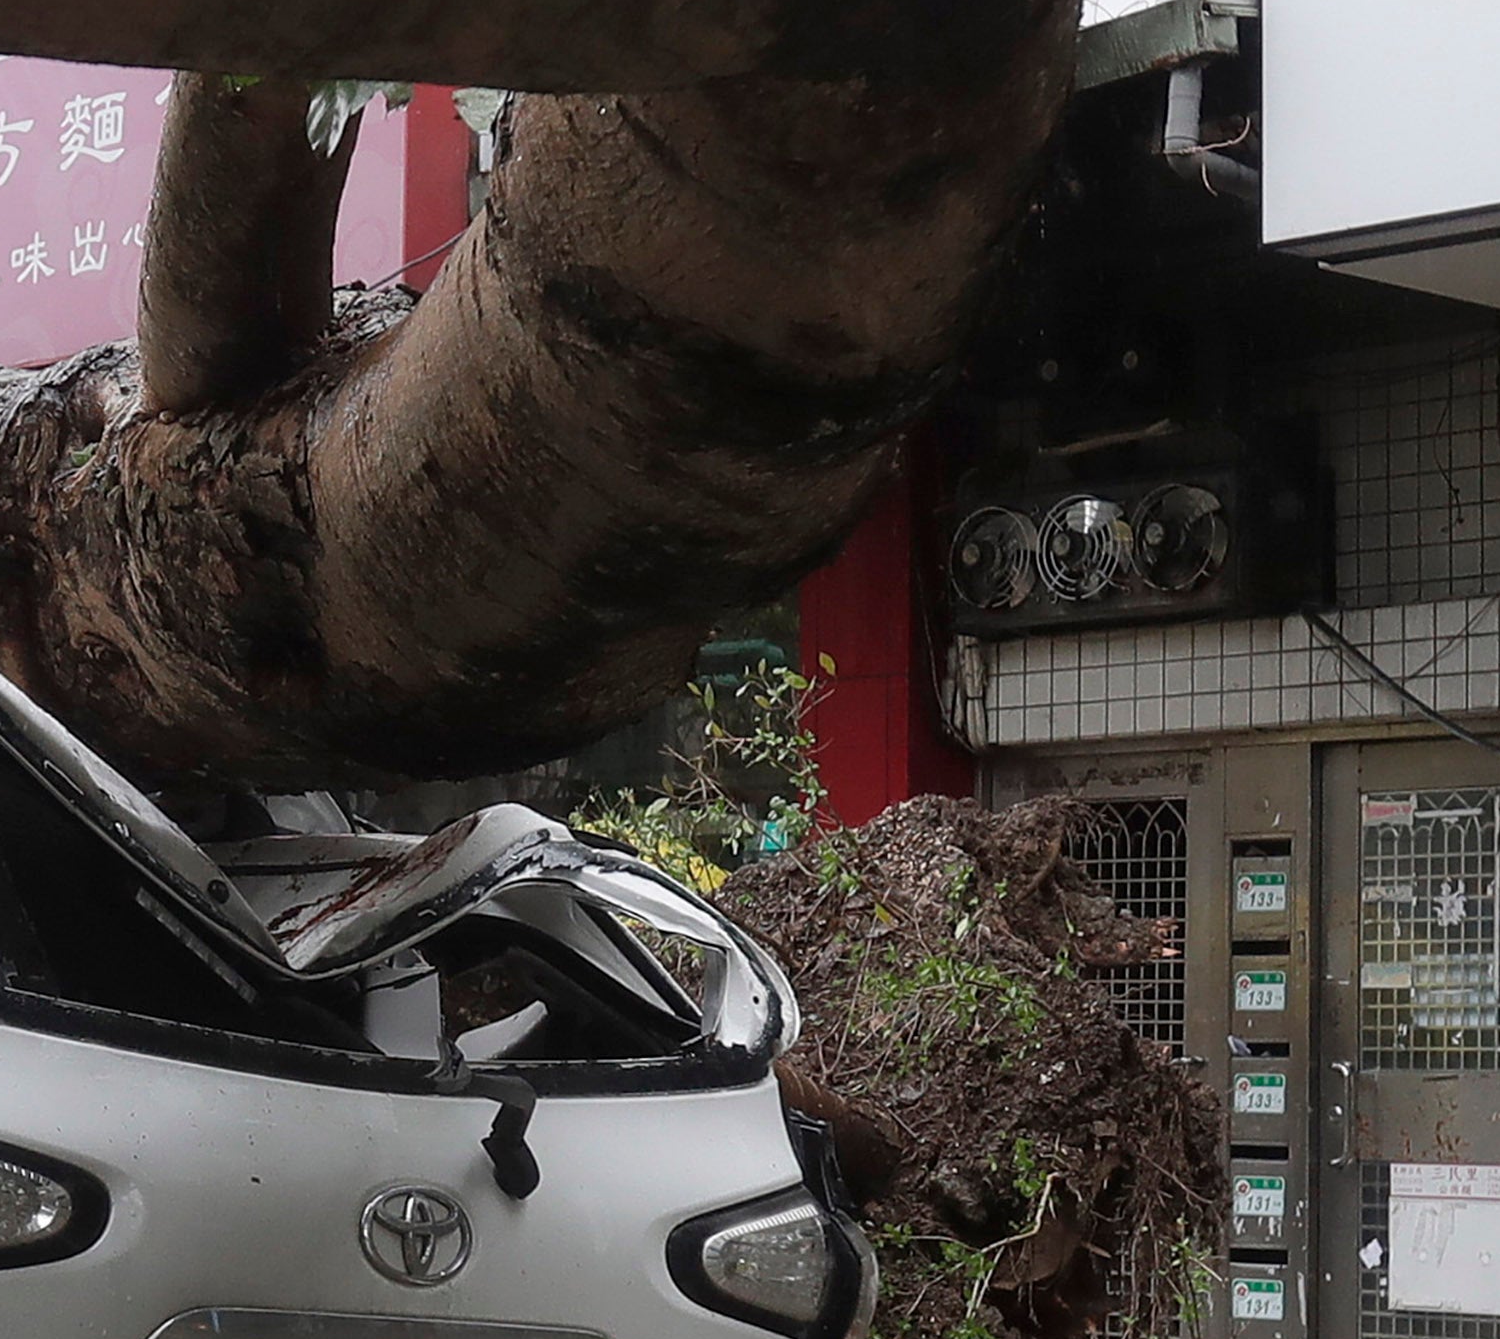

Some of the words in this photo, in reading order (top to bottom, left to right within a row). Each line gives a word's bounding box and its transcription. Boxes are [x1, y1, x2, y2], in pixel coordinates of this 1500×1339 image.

[1250, 892, 1274, 907] 133
[1248, 990, 1273, 1006] 133
[1247, 1093, 1272, 1108] 133
[1247, 1196, 1271, 1212] 131
